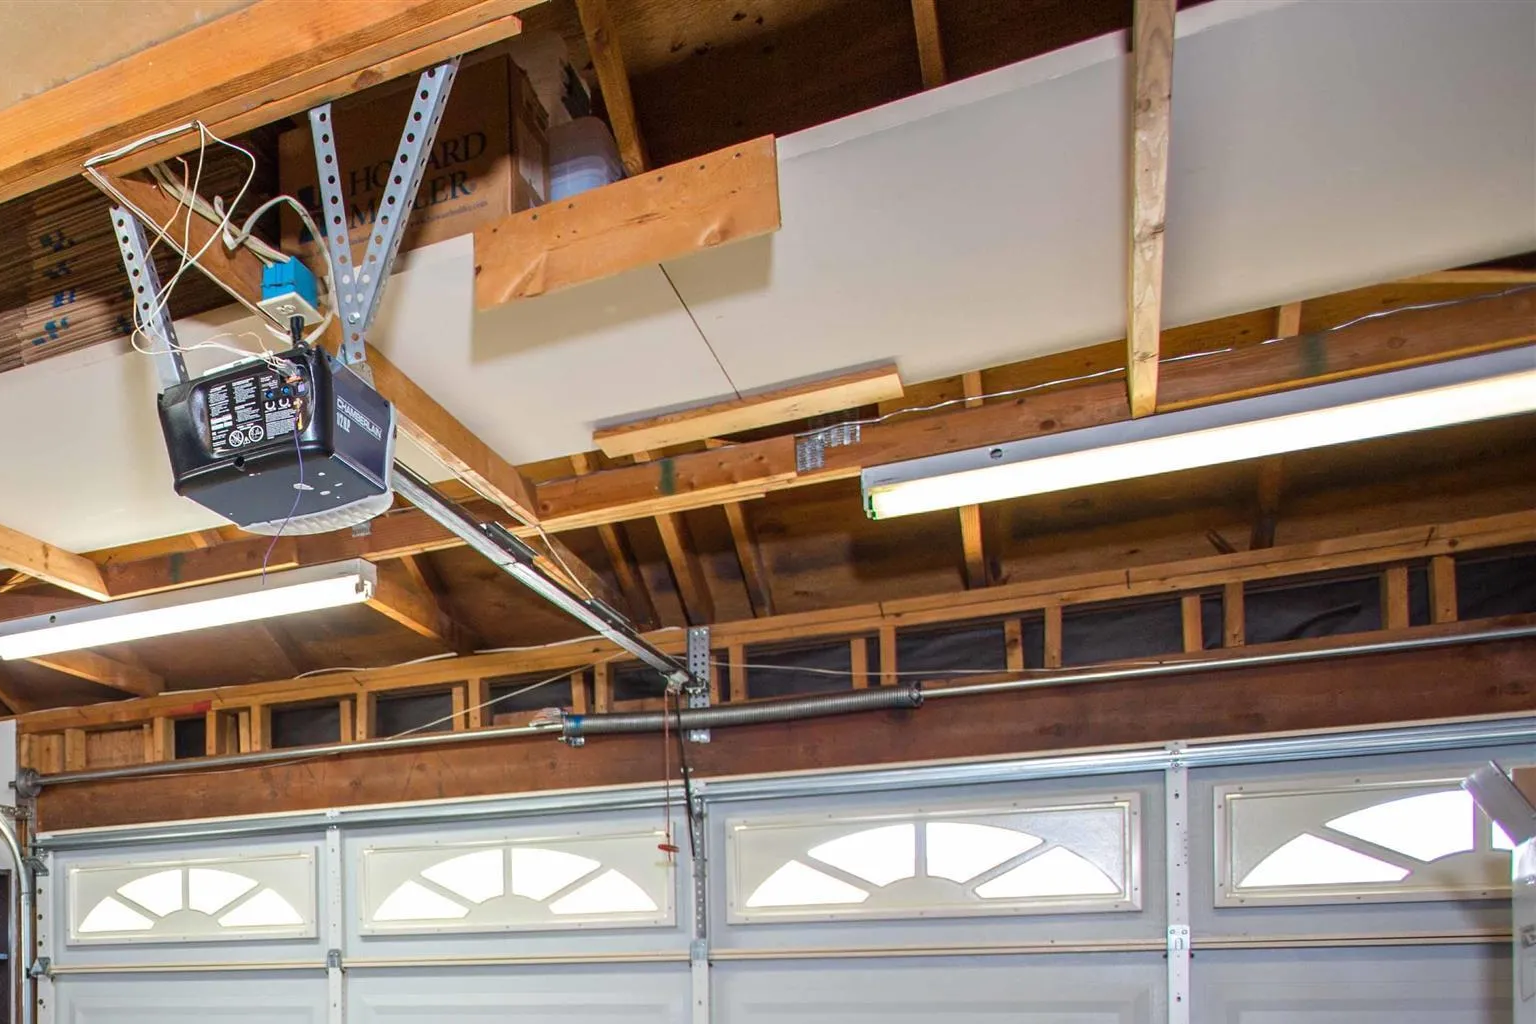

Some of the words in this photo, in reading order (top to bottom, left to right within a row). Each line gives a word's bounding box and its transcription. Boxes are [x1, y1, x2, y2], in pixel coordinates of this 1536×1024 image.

[349, 131, 487, 195] HOARD
[350, 170, 471, 228] MLER
[337, 398, 382, 440] CHAMBERLAIN
